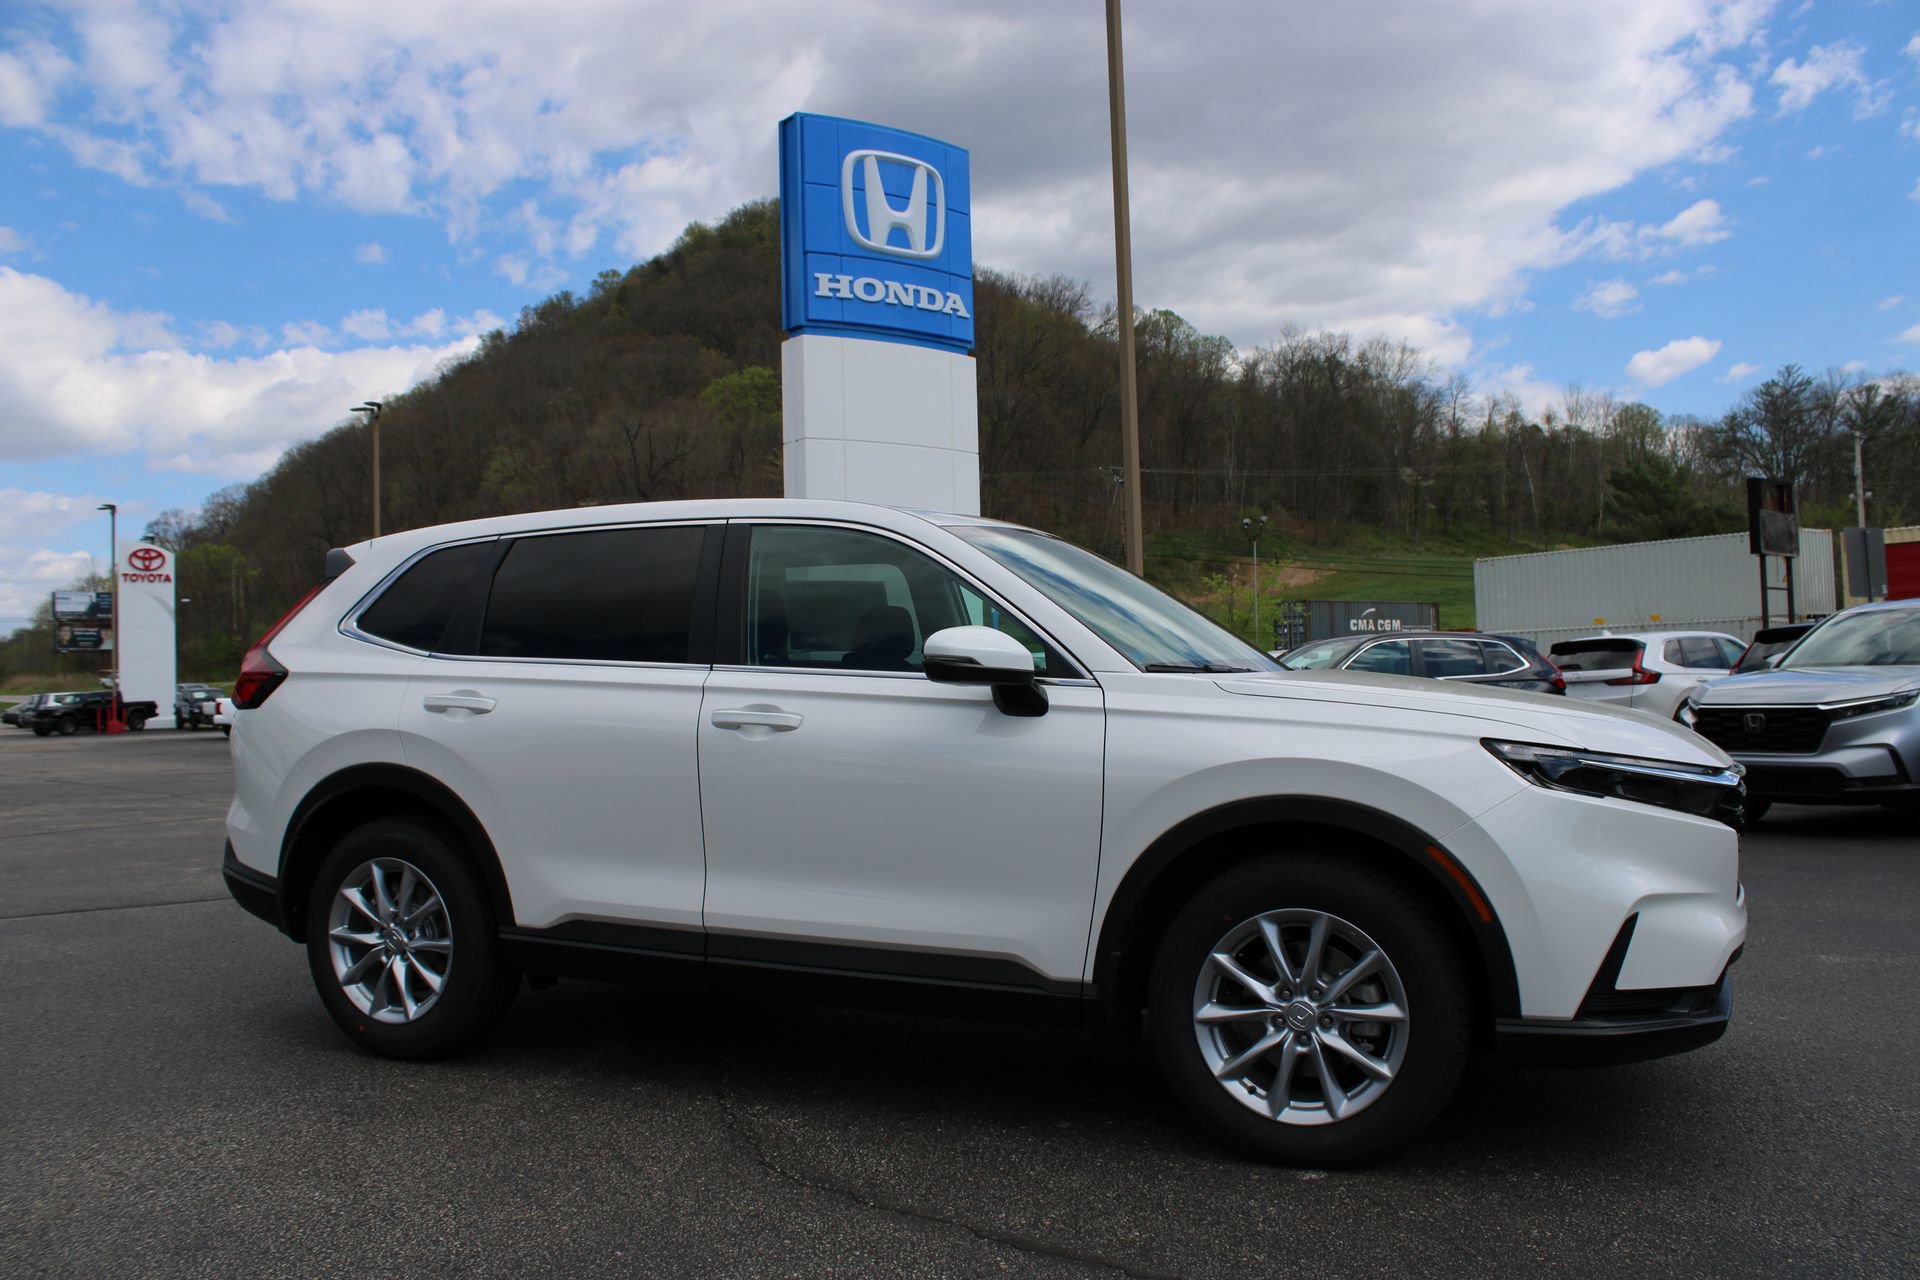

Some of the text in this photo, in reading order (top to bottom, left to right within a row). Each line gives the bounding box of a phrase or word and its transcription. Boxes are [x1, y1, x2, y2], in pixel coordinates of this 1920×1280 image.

[814, 272, 970, 318] HONDA
[121, 572, 172, 584] TOYOTA
[1349, 619, 1401, 631] CMA CGM
